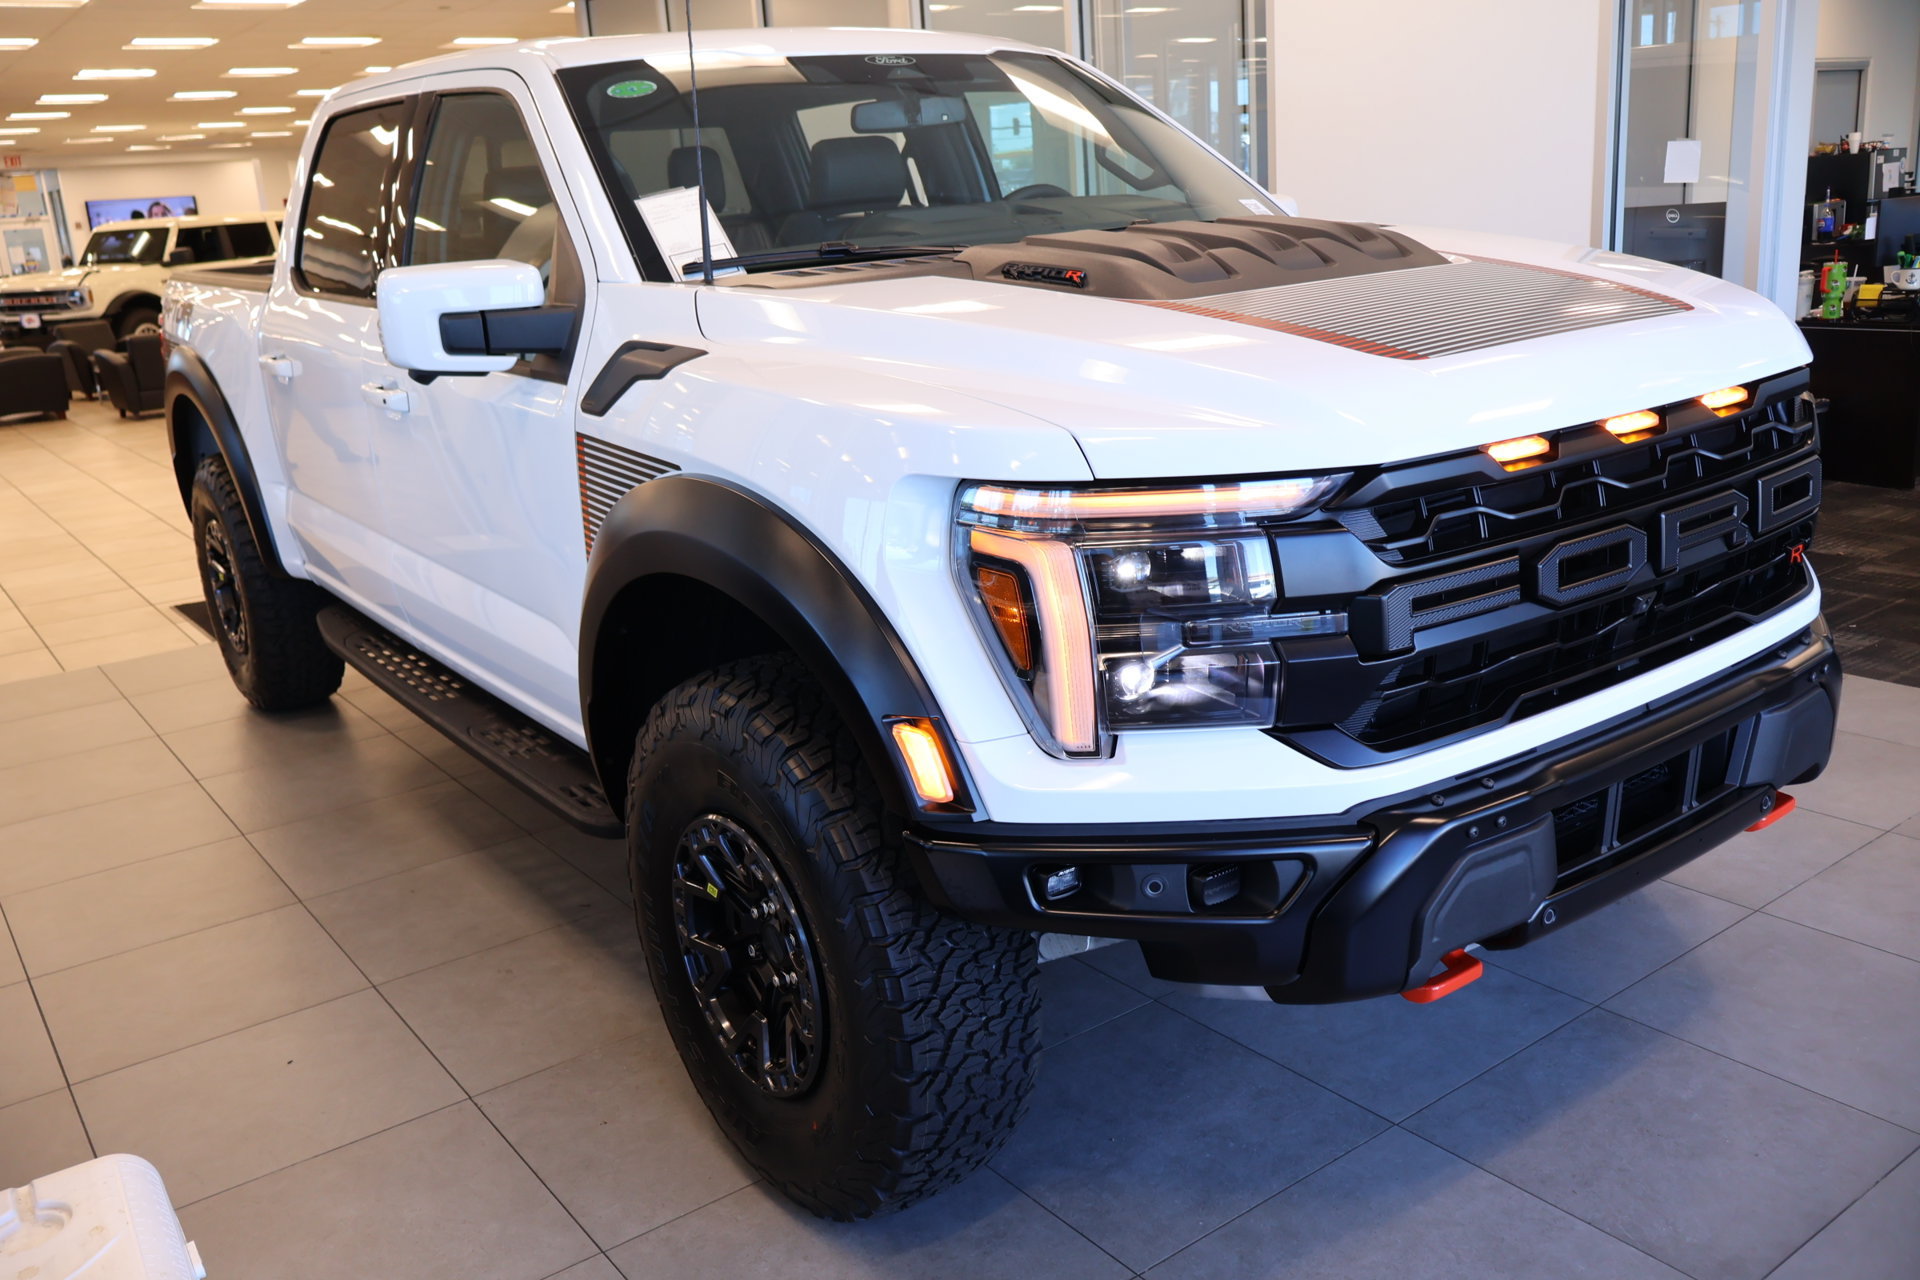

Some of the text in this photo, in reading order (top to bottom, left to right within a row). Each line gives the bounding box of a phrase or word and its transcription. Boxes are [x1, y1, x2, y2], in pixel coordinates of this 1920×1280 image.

[1002, 263, 1085, 284] RAPTOR
[1382, 454, 1822, 652] FORD
[1790, 543, 1804, 563] R
